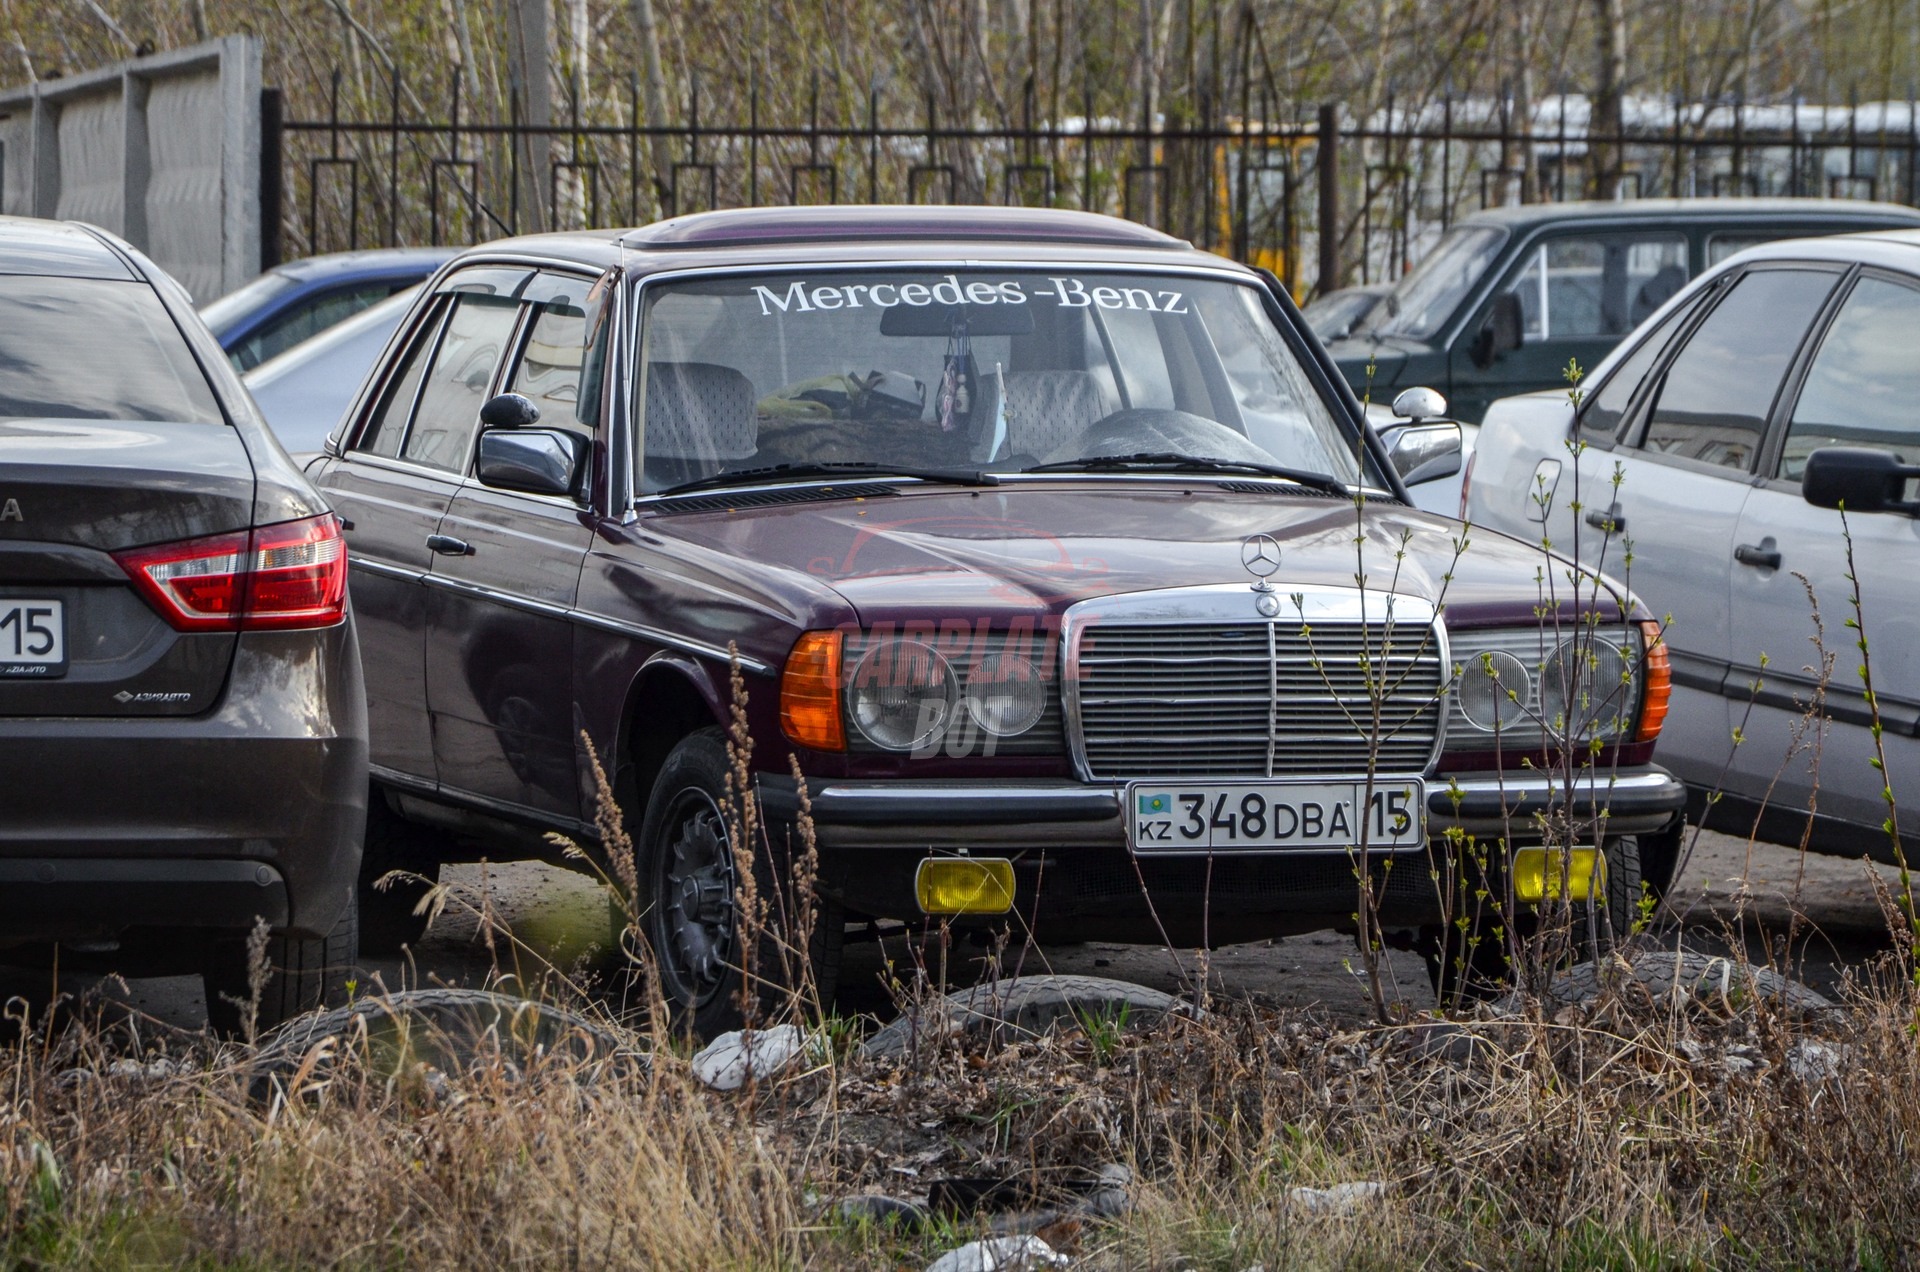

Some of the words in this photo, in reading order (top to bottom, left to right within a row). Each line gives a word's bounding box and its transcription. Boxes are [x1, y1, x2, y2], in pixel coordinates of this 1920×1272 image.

[750, 275, 1189, 315] Mercedes-Benz
[0, 607, 55, 656] 15
[1139, 821, 1172, 841] KZ
[1367, 790, 1413, 837] 15
